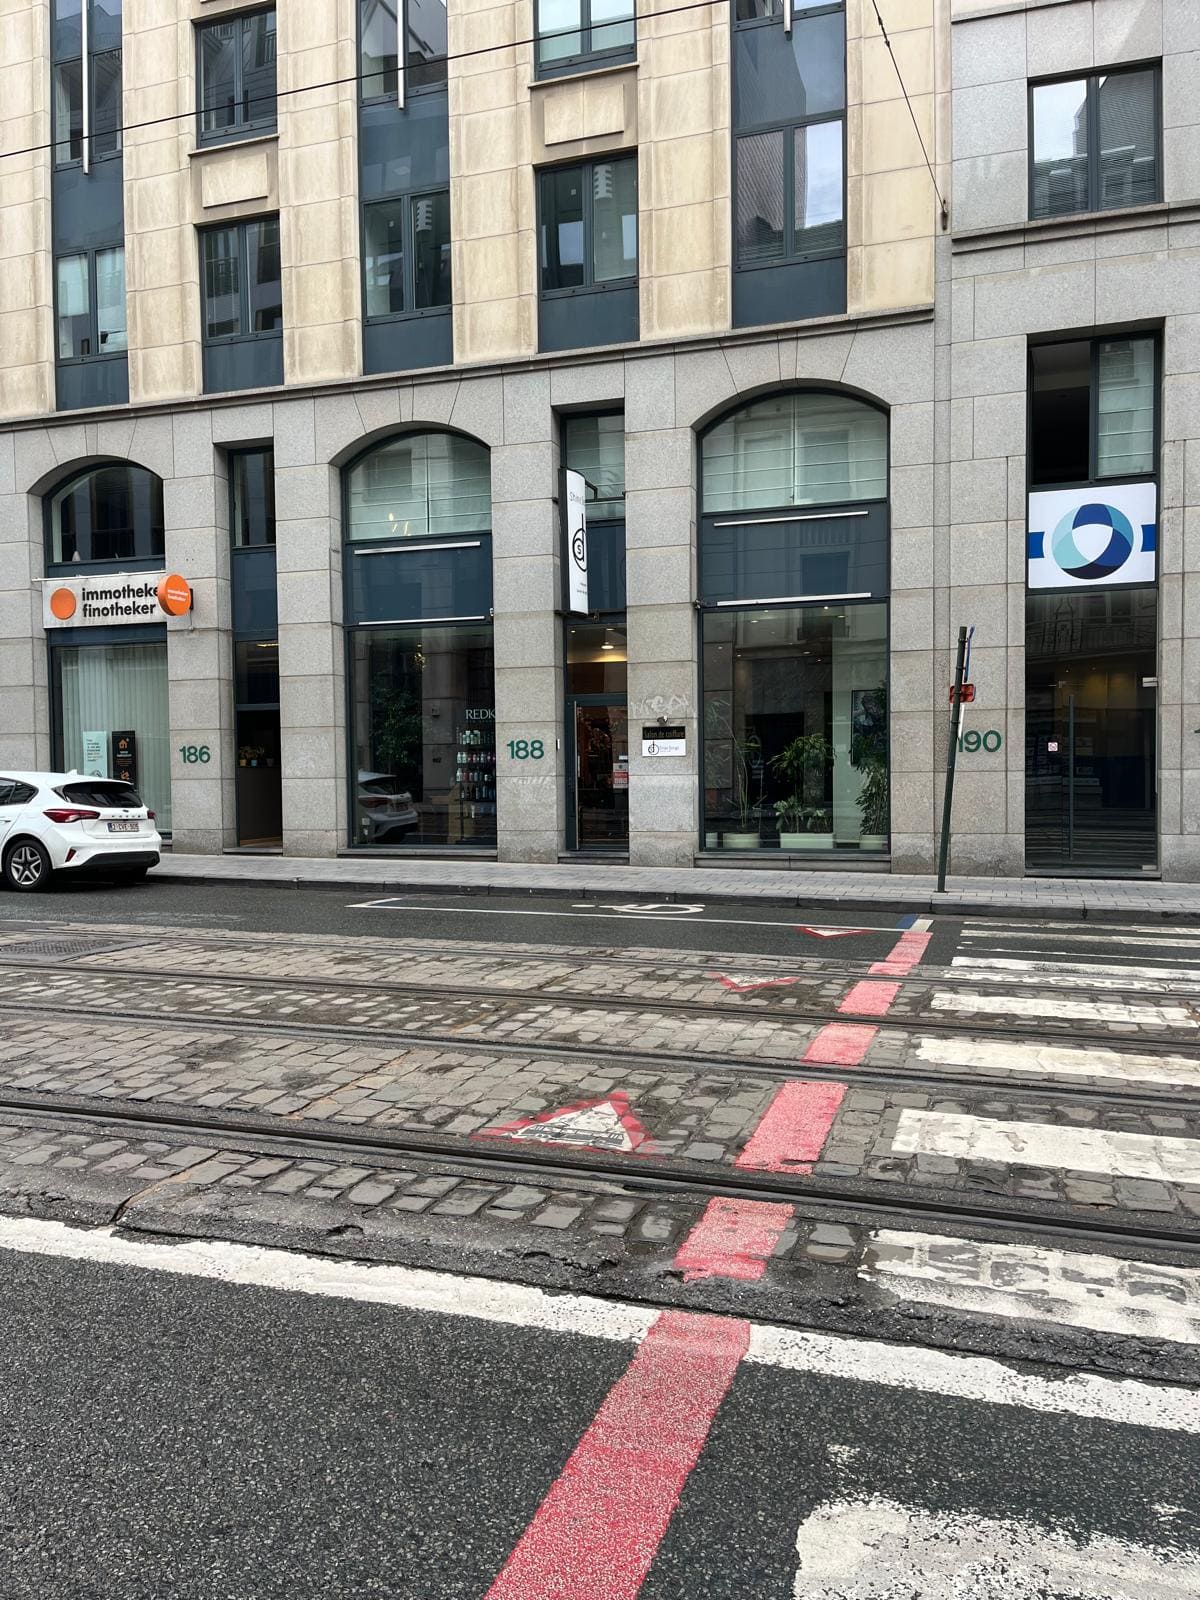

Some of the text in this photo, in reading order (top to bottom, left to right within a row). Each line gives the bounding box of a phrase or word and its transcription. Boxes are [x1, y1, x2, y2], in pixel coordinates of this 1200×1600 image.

[81, 583, 158, 601] immotheke
[82, 601, 156, 617] finotheker
[465, 708, 496, 719] REDK
[179, 745, 211, 764] 186
[507, 740, 544, 760] 188
